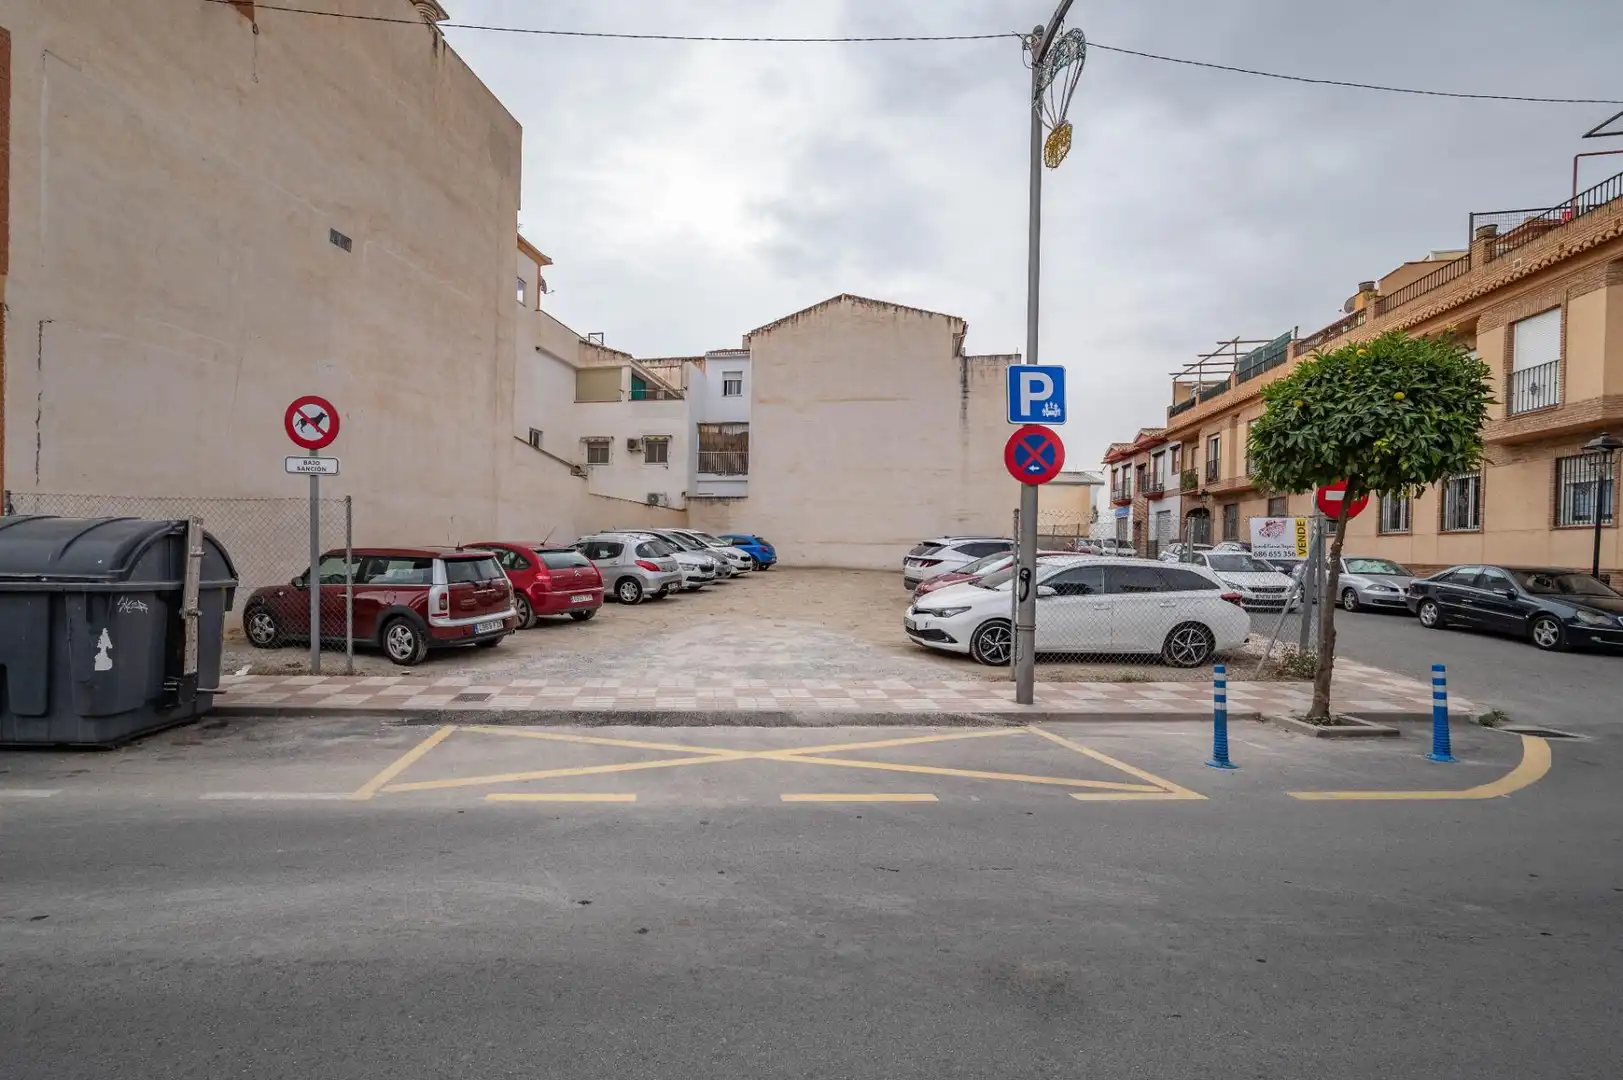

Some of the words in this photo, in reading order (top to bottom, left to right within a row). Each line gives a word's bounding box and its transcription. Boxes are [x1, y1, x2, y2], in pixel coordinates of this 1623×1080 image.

[1020, 371, 1054, 416] P
[1253, 550, 1267, 558] 686
[1268, 550, 1282, 558] 655
[1283, 550, 1296, 558] 356
[1296, 520, 1307, 556] VENDE
